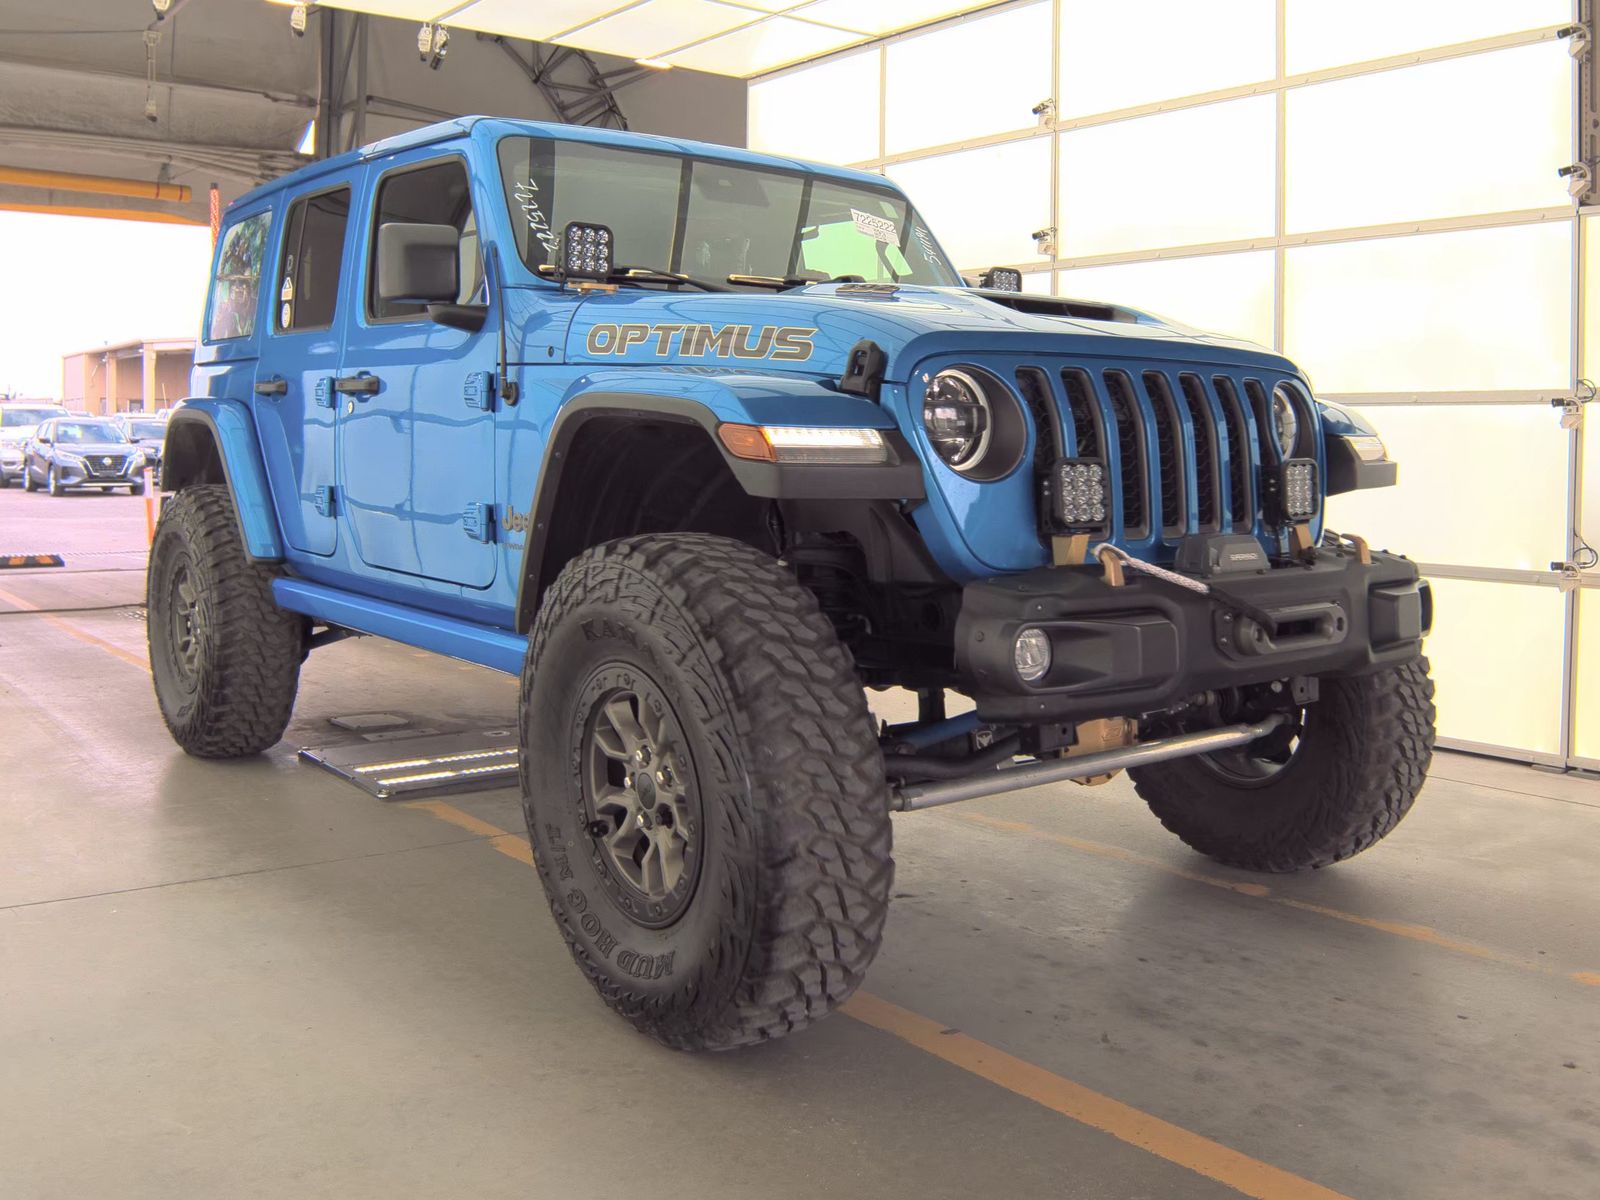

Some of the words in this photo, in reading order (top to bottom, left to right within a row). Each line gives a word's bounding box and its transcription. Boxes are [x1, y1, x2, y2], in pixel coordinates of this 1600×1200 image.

[586, 323, 818, 362] OPTIMUS
[501, 505, 530, 532] Jee
[616, 950, 676, 979] MUD
